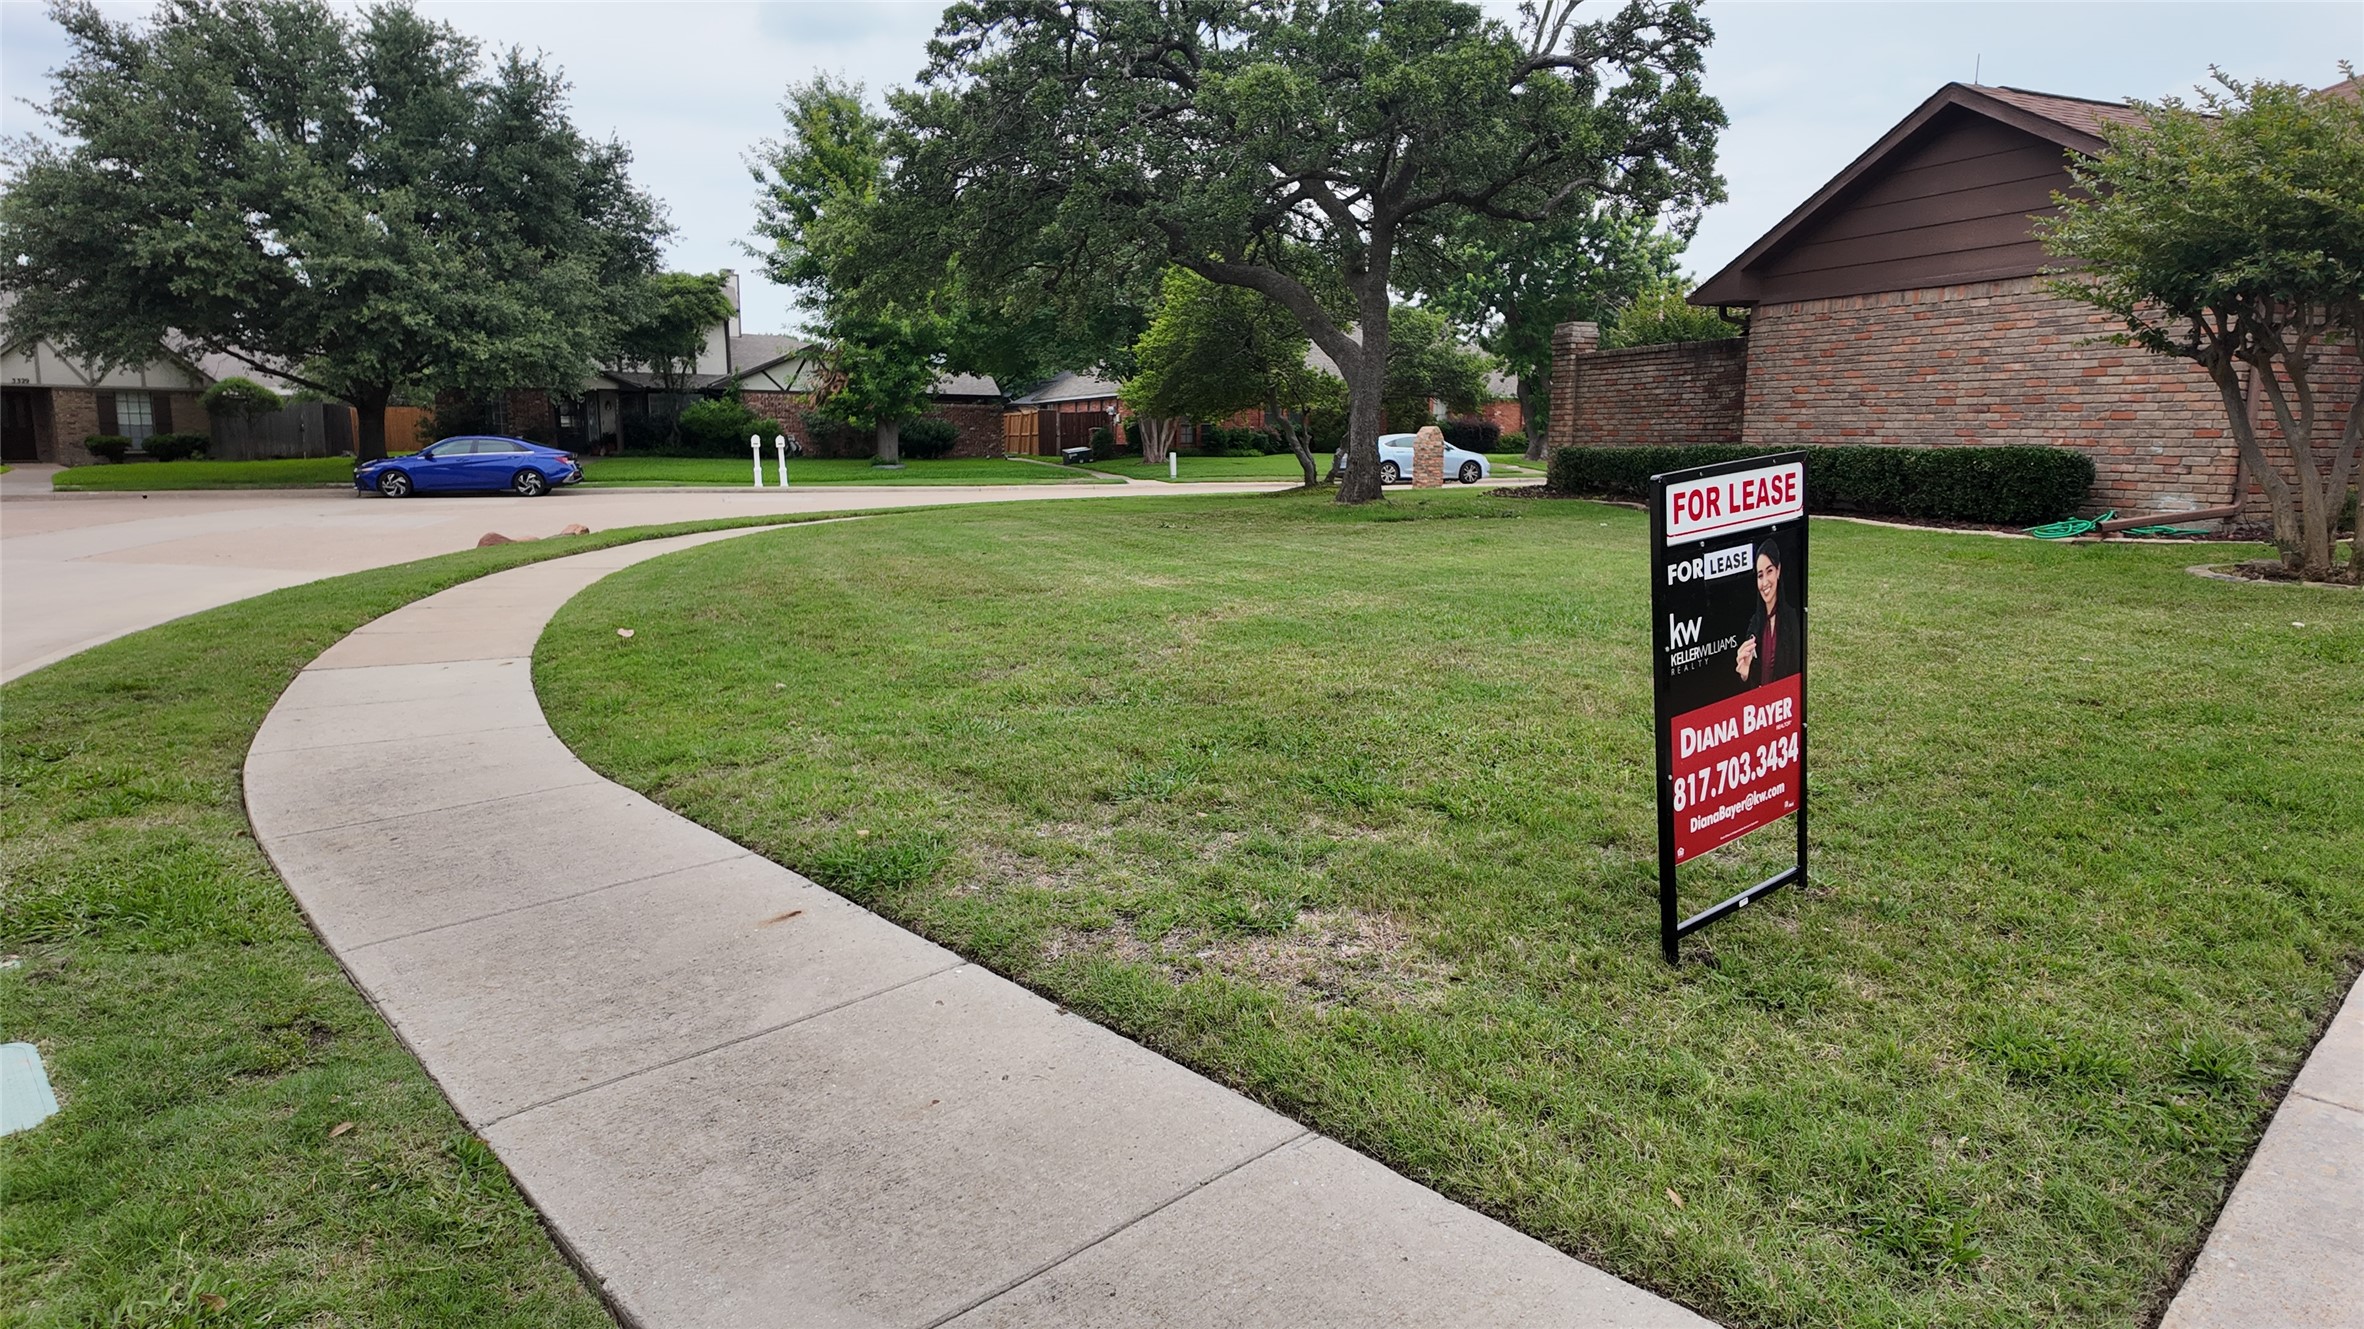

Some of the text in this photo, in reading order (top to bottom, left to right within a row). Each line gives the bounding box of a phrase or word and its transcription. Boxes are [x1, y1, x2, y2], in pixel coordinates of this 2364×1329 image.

[1673, 472, 1796, 525] FOR LEASE
[1668, 551, 1748, 585] FOR LEASE
[1671, 658, 1709, 676] REALTY
[1680, 697, 1793, 759] DIANA BAYER
[1673, 732, 1799, 812] 817.703.3434
[1690, 783, 1785, 833] DianaBayer@kw.com
